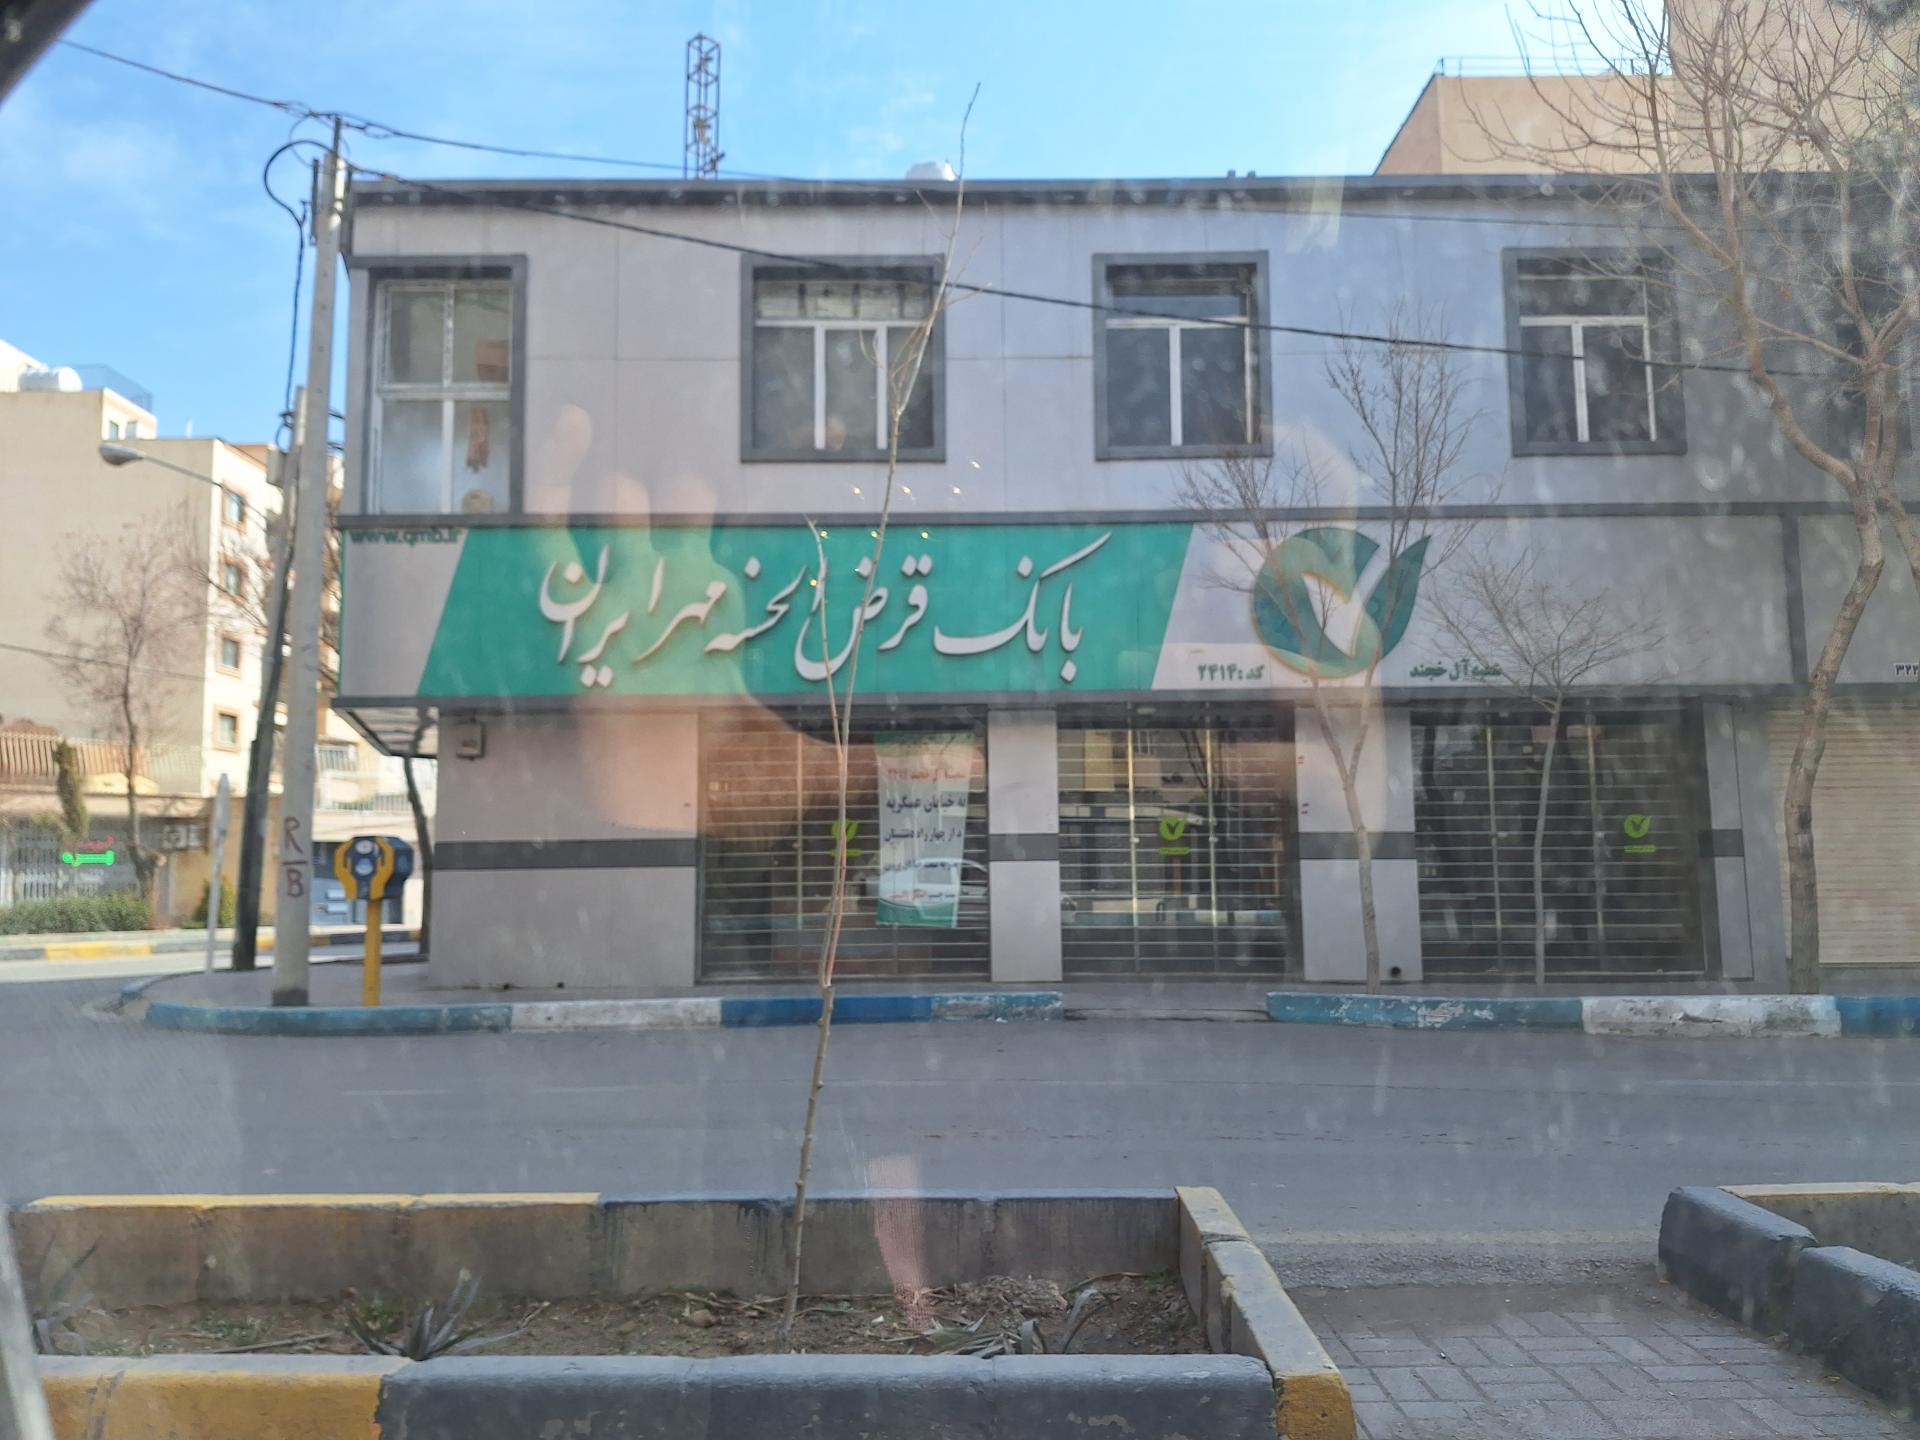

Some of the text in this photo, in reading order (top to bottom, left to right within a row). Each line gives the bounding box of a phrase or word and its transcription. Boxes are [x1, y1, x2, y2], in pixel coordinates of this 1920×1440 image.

[538, 543, 666, 688] ایران
[633, 580, 728, 664] مهر
[794, 553, 933, 682] قرض
[933, 531, 1112, 683] بانک
[286, 868, 305, 898] B
